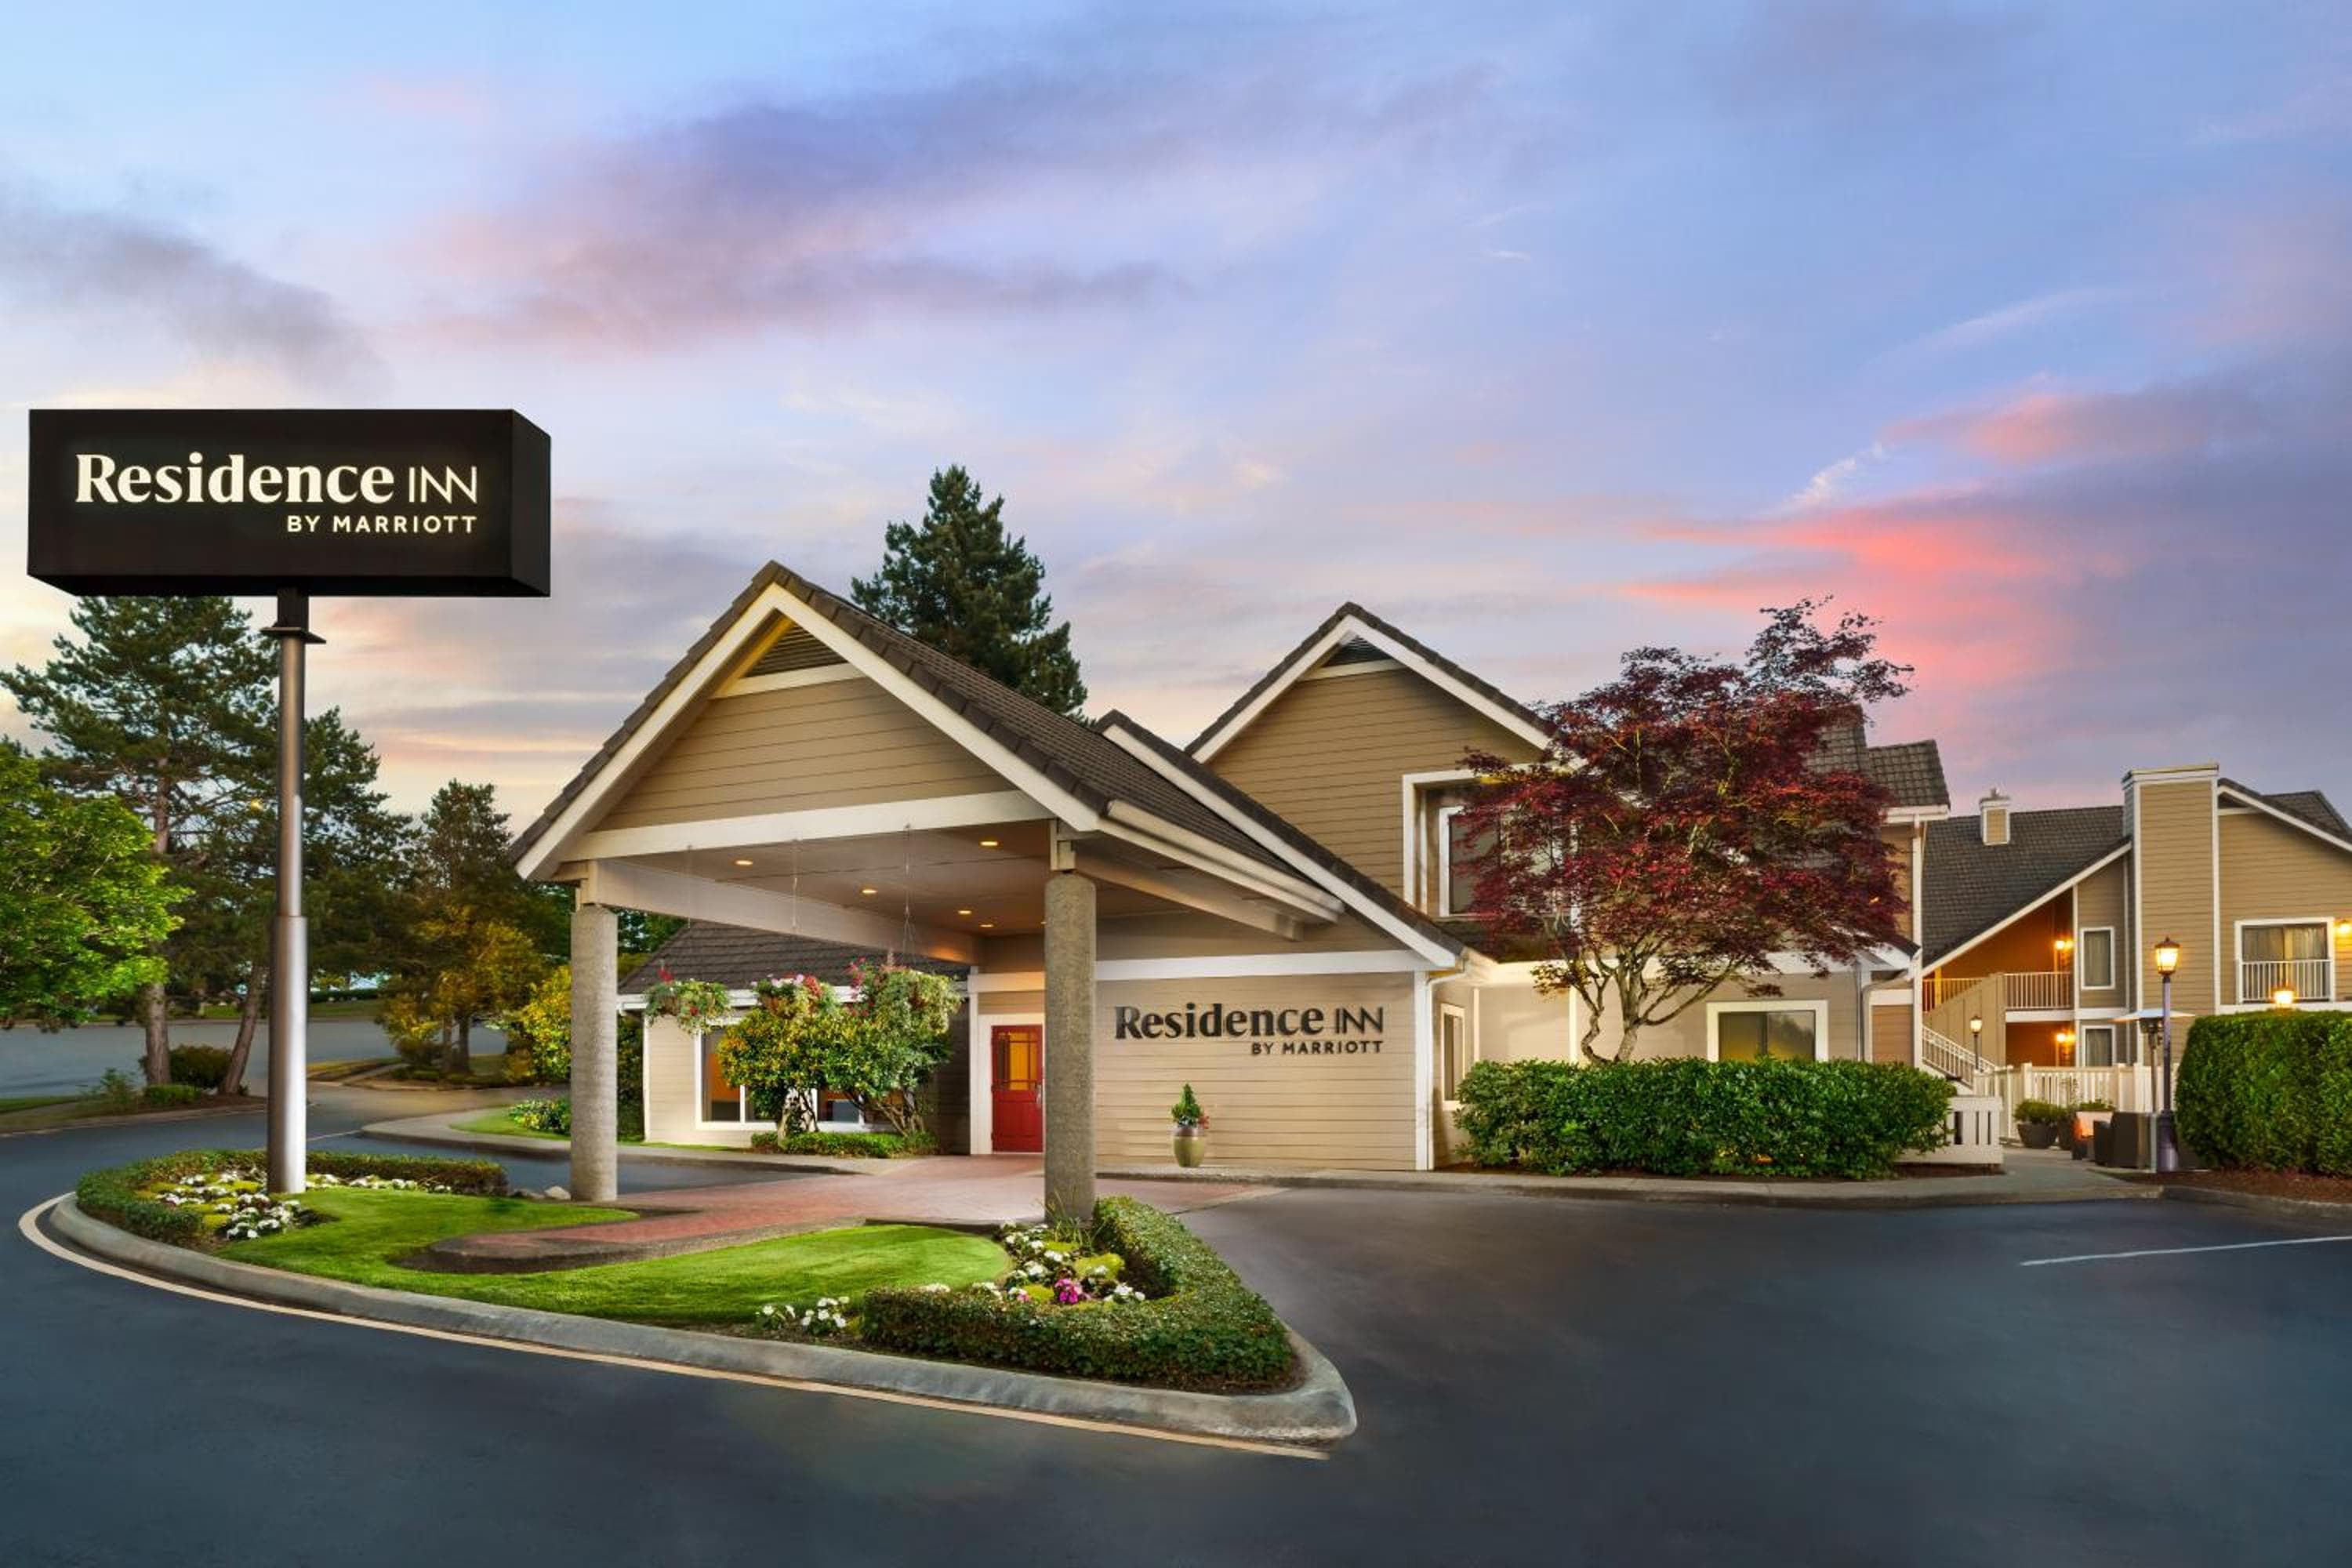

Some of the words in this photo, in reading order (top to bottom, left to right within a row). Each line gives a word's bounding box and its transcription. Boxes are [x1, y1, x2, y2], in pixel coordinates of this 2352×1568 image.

[75, 452, 394, 503] Residence
[408, 466, 477, 503] INN
[287, 514, 321, 533] BY
[332, 515, 477, 534] MARRIOTT
[1115, 1003, 1324, 1039] Residence
[1334, 1007, 1384, 1034] INN
[1251, 1042, 1275, 1055] BY
[1283, 1040, 1384, 1054] MARRIOTT
